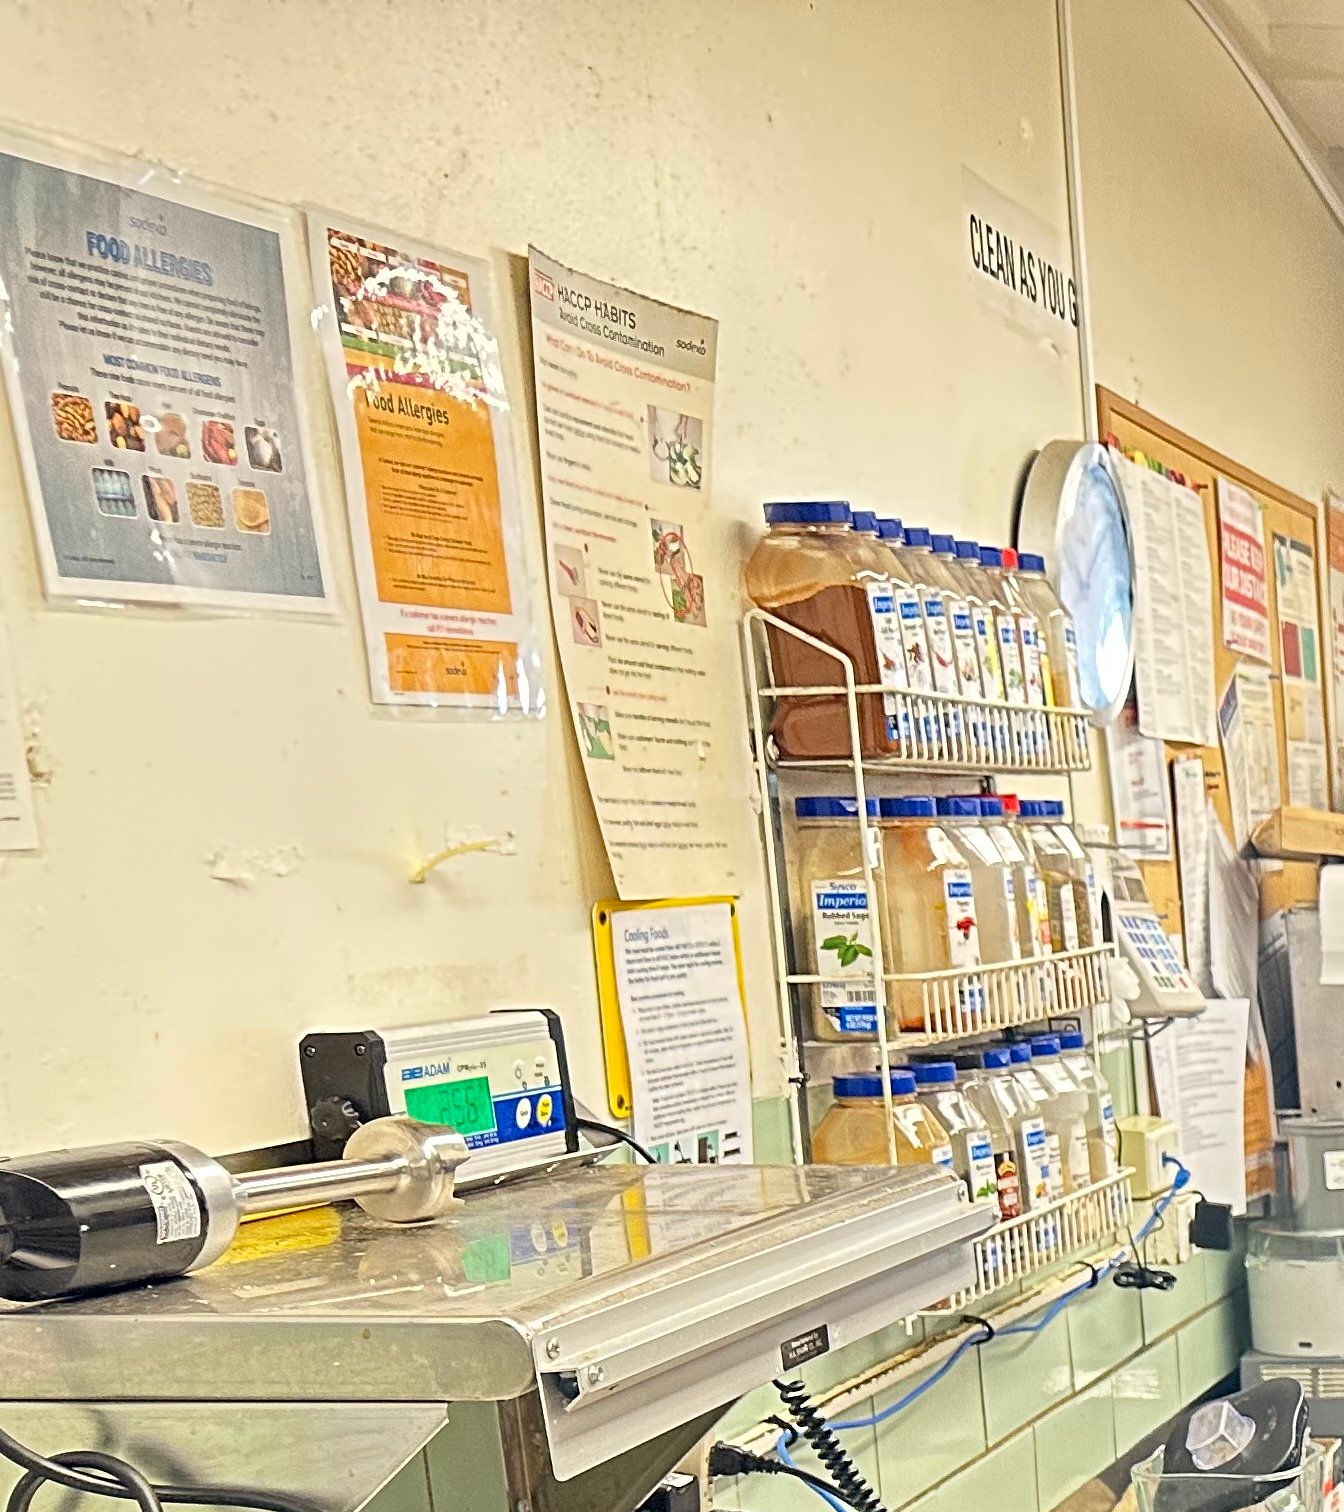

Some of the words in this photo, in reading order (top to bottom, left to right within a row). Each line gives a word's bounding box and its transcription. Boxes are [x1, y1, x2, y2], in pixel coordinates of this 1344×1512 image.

[86, 230, 131, 265] FOOD
[133, 243, 214, 287] ALLERGIES
[970, 214, 1016, 291] CLEAN
[1020, 246, 1037, 303] AS
[1038, 258, 1065, 320] YOU
[558, 284, 591, 313] HACCP
[595, 300, 636, 329] HABITS
[580, 314, 601, 336] Cross
[603, 326, 665, 358] Contamination
[676, 338, 706, 355] sodexo
[398, 396, 449, 426] Allergies
[818, 894, 867, 908] Imperia
[424, 1062, 450, 1077] ADAM
